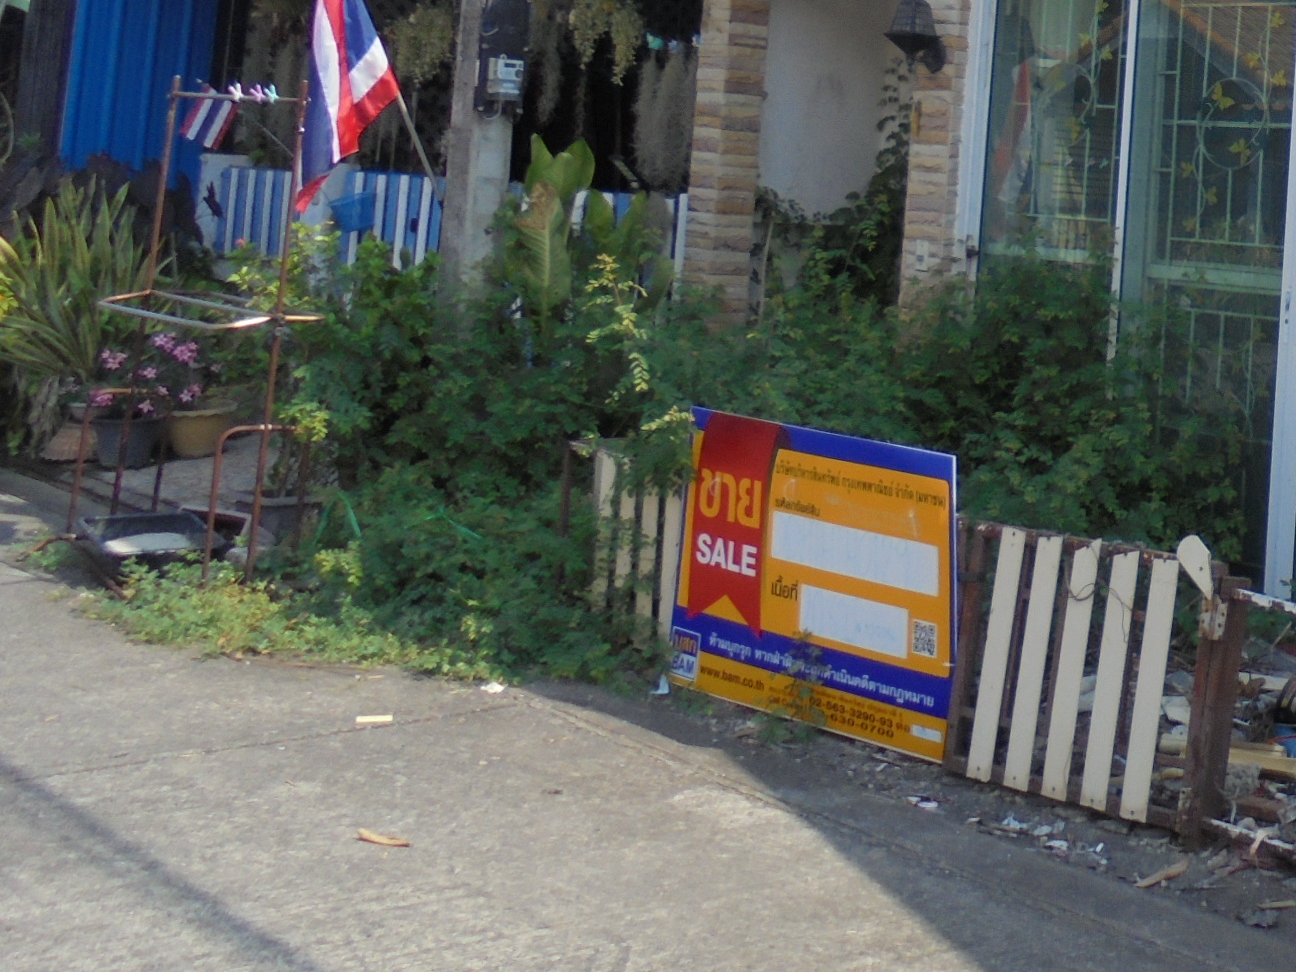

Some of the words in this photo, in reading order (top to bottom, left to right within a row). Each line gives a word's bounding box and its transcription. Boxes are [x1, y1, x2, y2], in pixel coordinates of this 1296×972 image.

[699, 467, 762, 529] ขาย
[695, 532, 758, 577] SALE
[771, 574, 799, 602] เนื้อที่
[709, 631, 752, 661] ห้ามบุกรุก
[672, 654, 696, 676] BAM
[700, 665, 765, 691] www.bam.co.th
